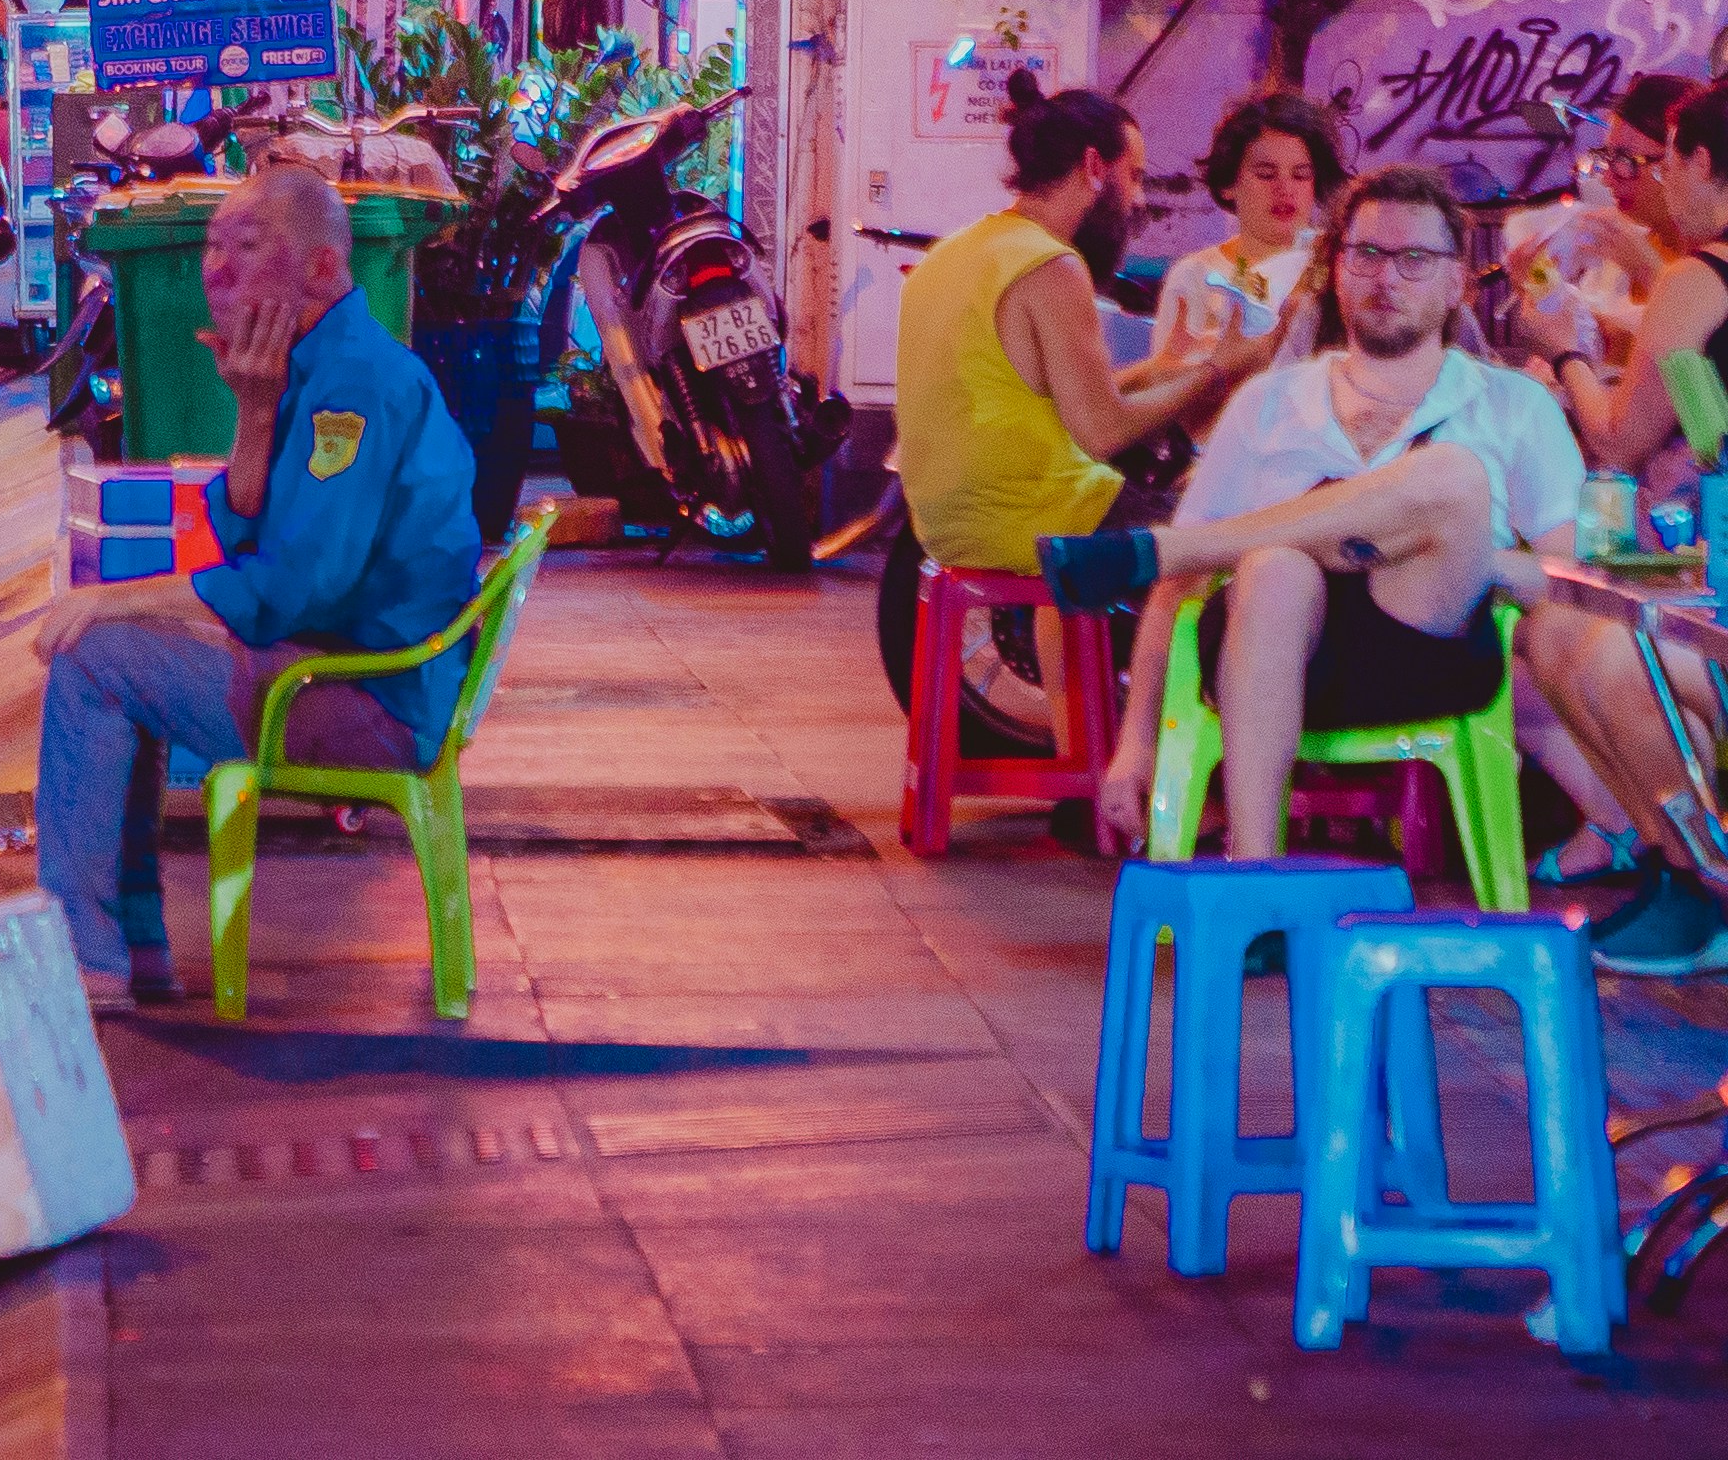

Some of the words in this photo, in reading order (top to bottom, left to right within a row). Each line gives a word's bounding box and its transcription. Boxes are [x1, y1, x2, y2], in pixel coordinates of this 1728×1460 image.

[99, 19, 225, 53] EXCHANGE
[230, 13, 325, 45] SERVICE
[106, 59, 167, 77] BOOKING
[170, 57, 206, 74] TOUR
[261, 49, 292, 66] FREE
